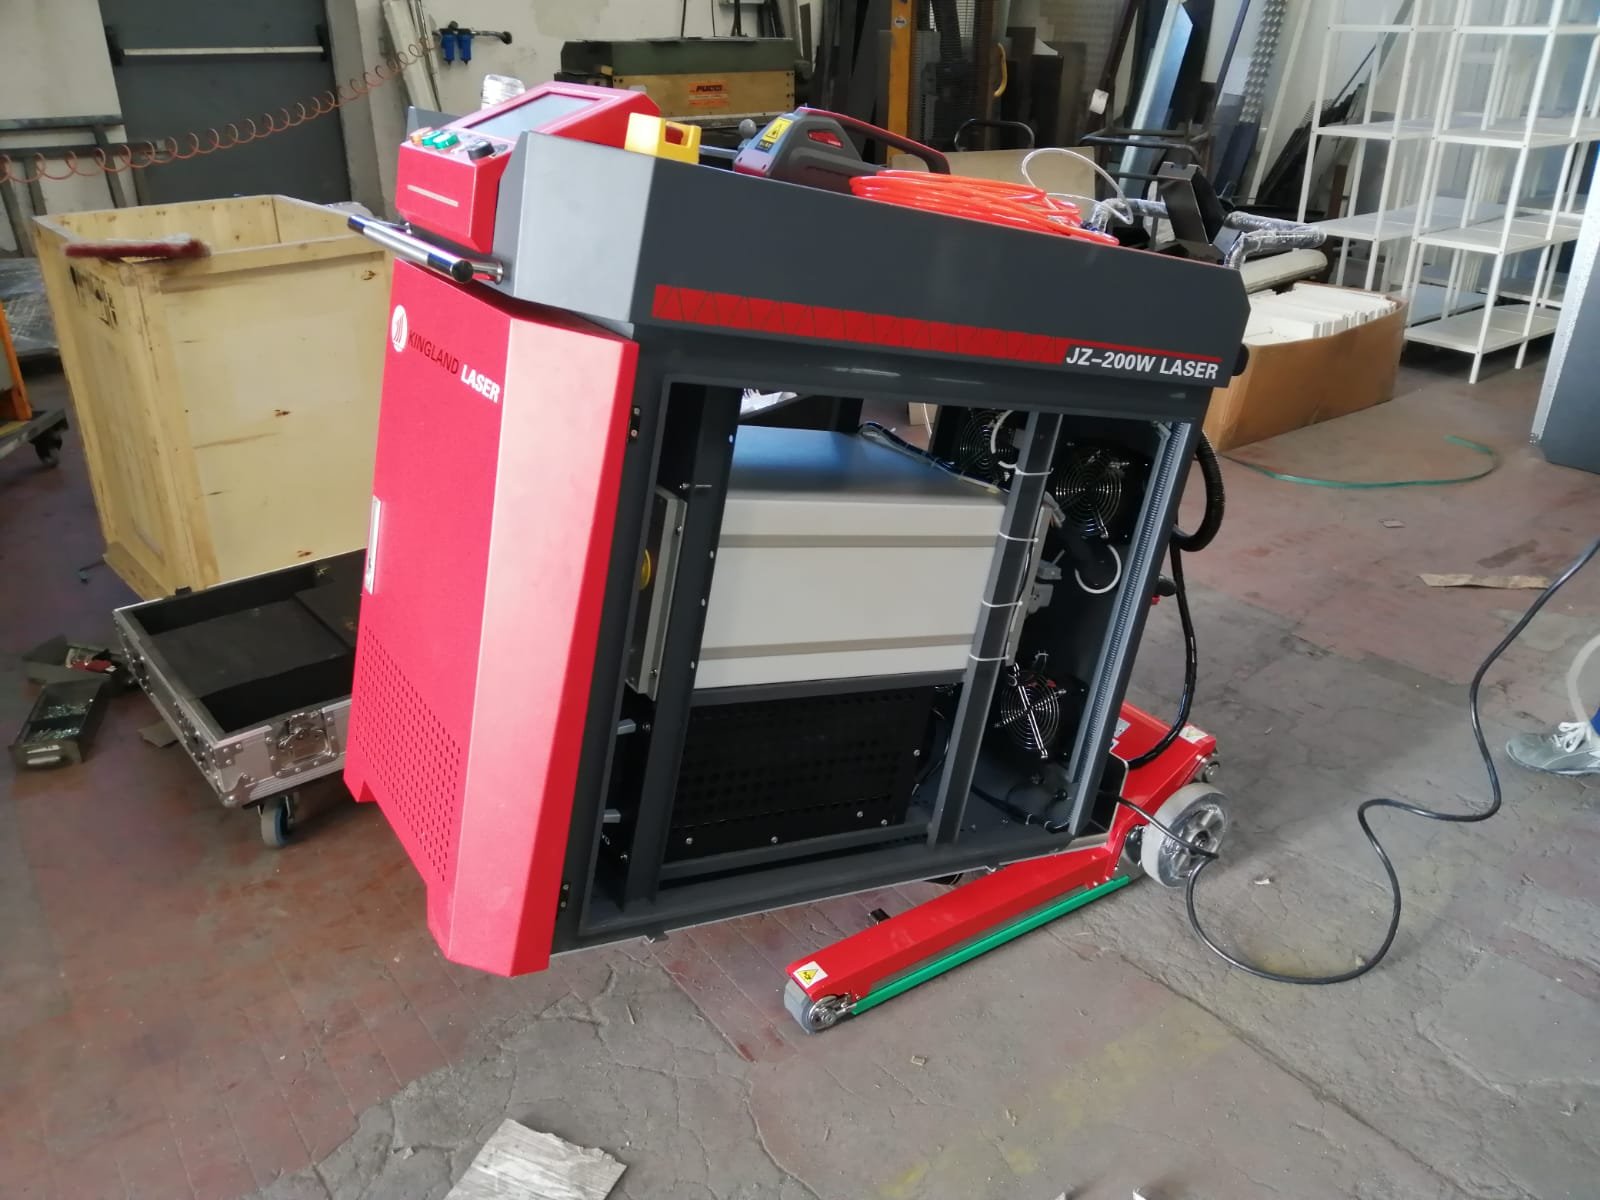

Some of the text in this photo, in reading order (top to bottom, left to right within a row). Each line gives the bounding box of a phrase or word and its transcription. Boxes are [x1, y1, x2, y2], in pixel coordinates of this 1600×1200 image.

[408, 330, 501, 403] KINGLAND LASER
[1065, 347, 1219, 379] JZ-200W LASER
